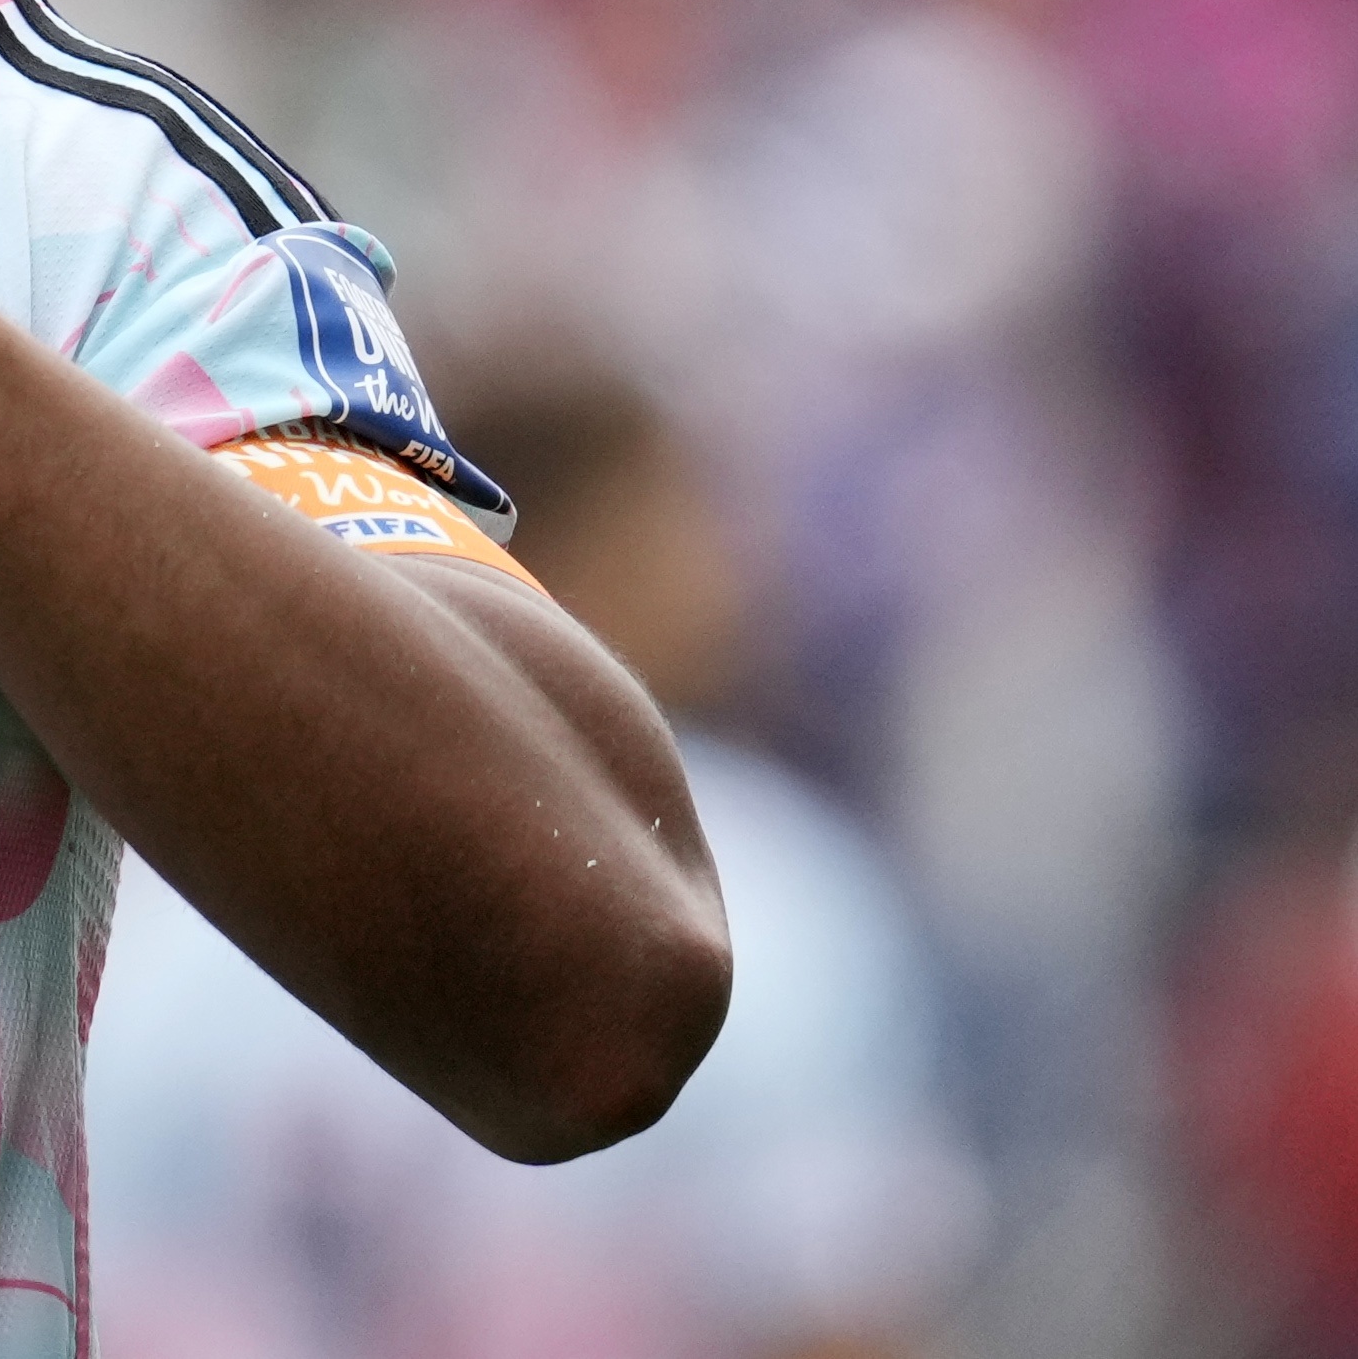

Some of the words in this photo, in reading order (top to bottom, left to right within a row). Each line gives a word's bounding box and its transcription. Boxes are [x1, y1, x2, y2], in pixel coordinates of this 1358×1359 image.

[344, 306, 426, 391] UNIT
[354, 368, 415, 421] the
[399, 440, 455, 482] FIFA
[325, 518, 441, 539] FIFA
